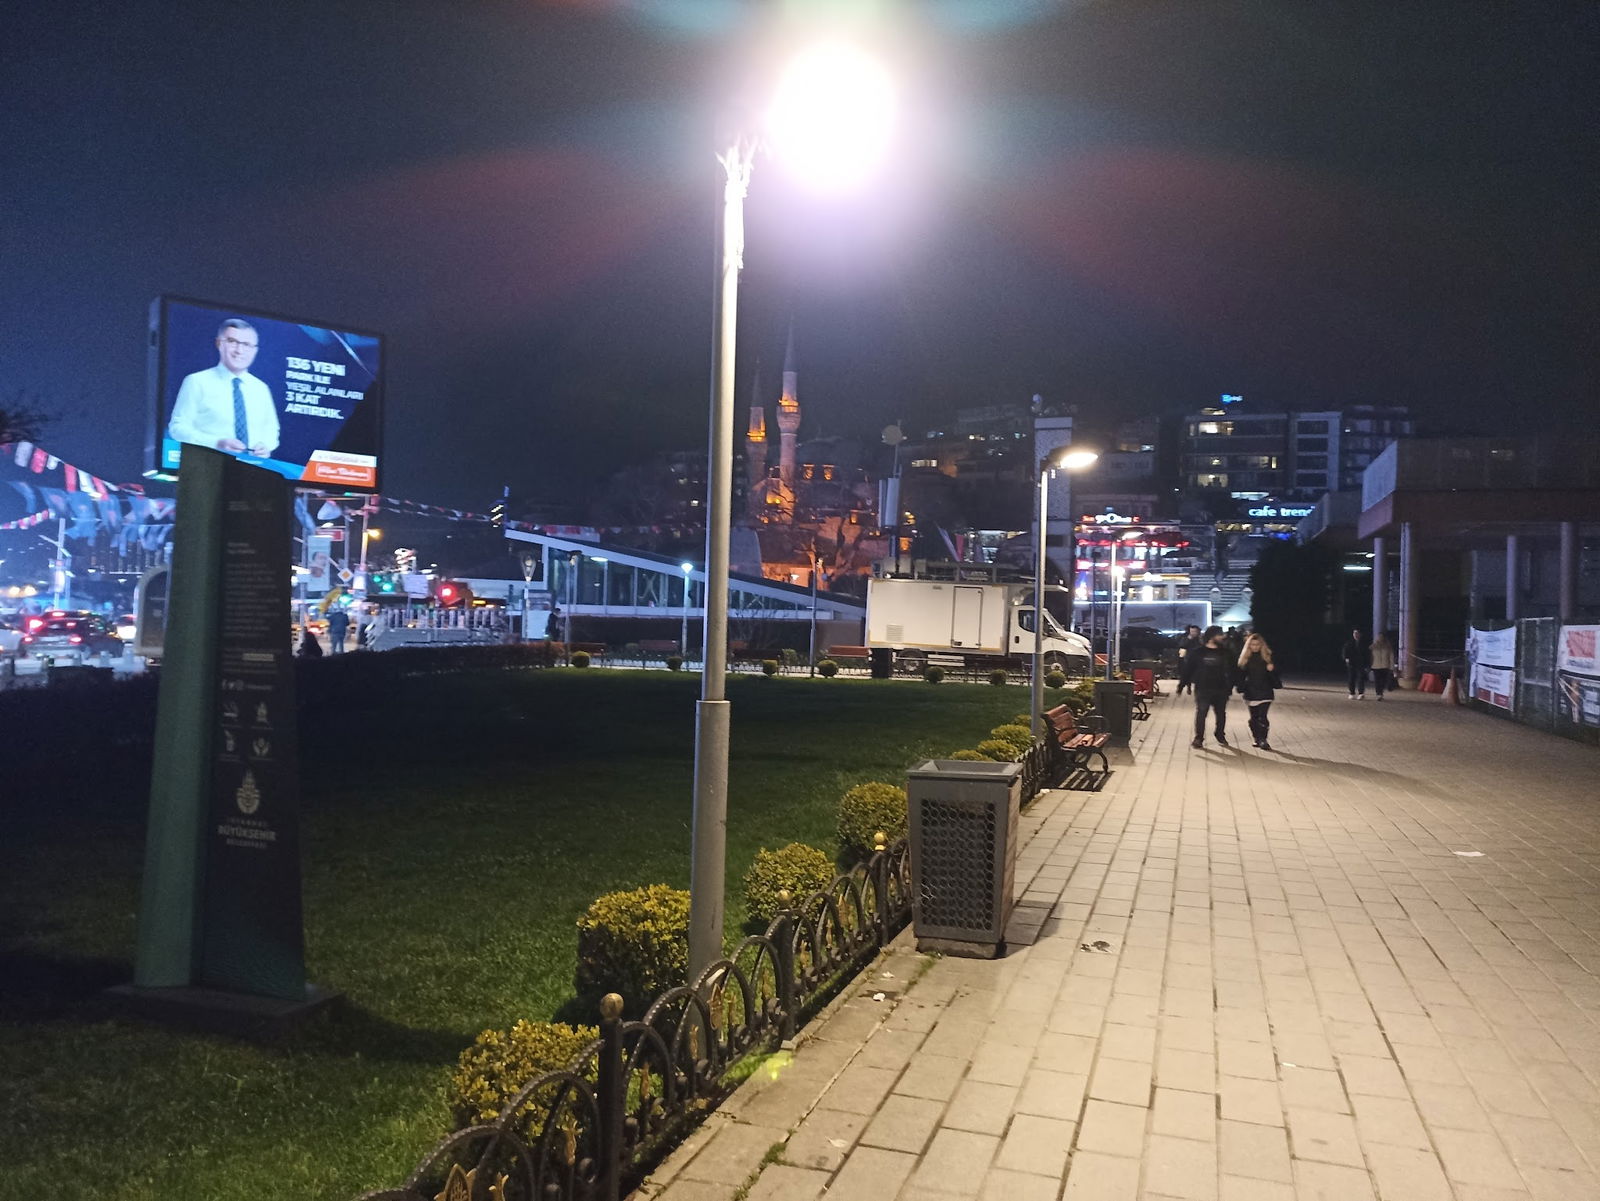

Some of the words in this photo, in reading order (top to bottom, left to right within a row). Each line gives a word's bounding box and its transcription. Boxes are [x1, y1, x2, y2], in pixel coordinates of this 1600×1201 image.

[285, 391, 295, 401] 3
[295, 392, 321, 405] KAT
[1248, 505, 1277, 517] cafe
